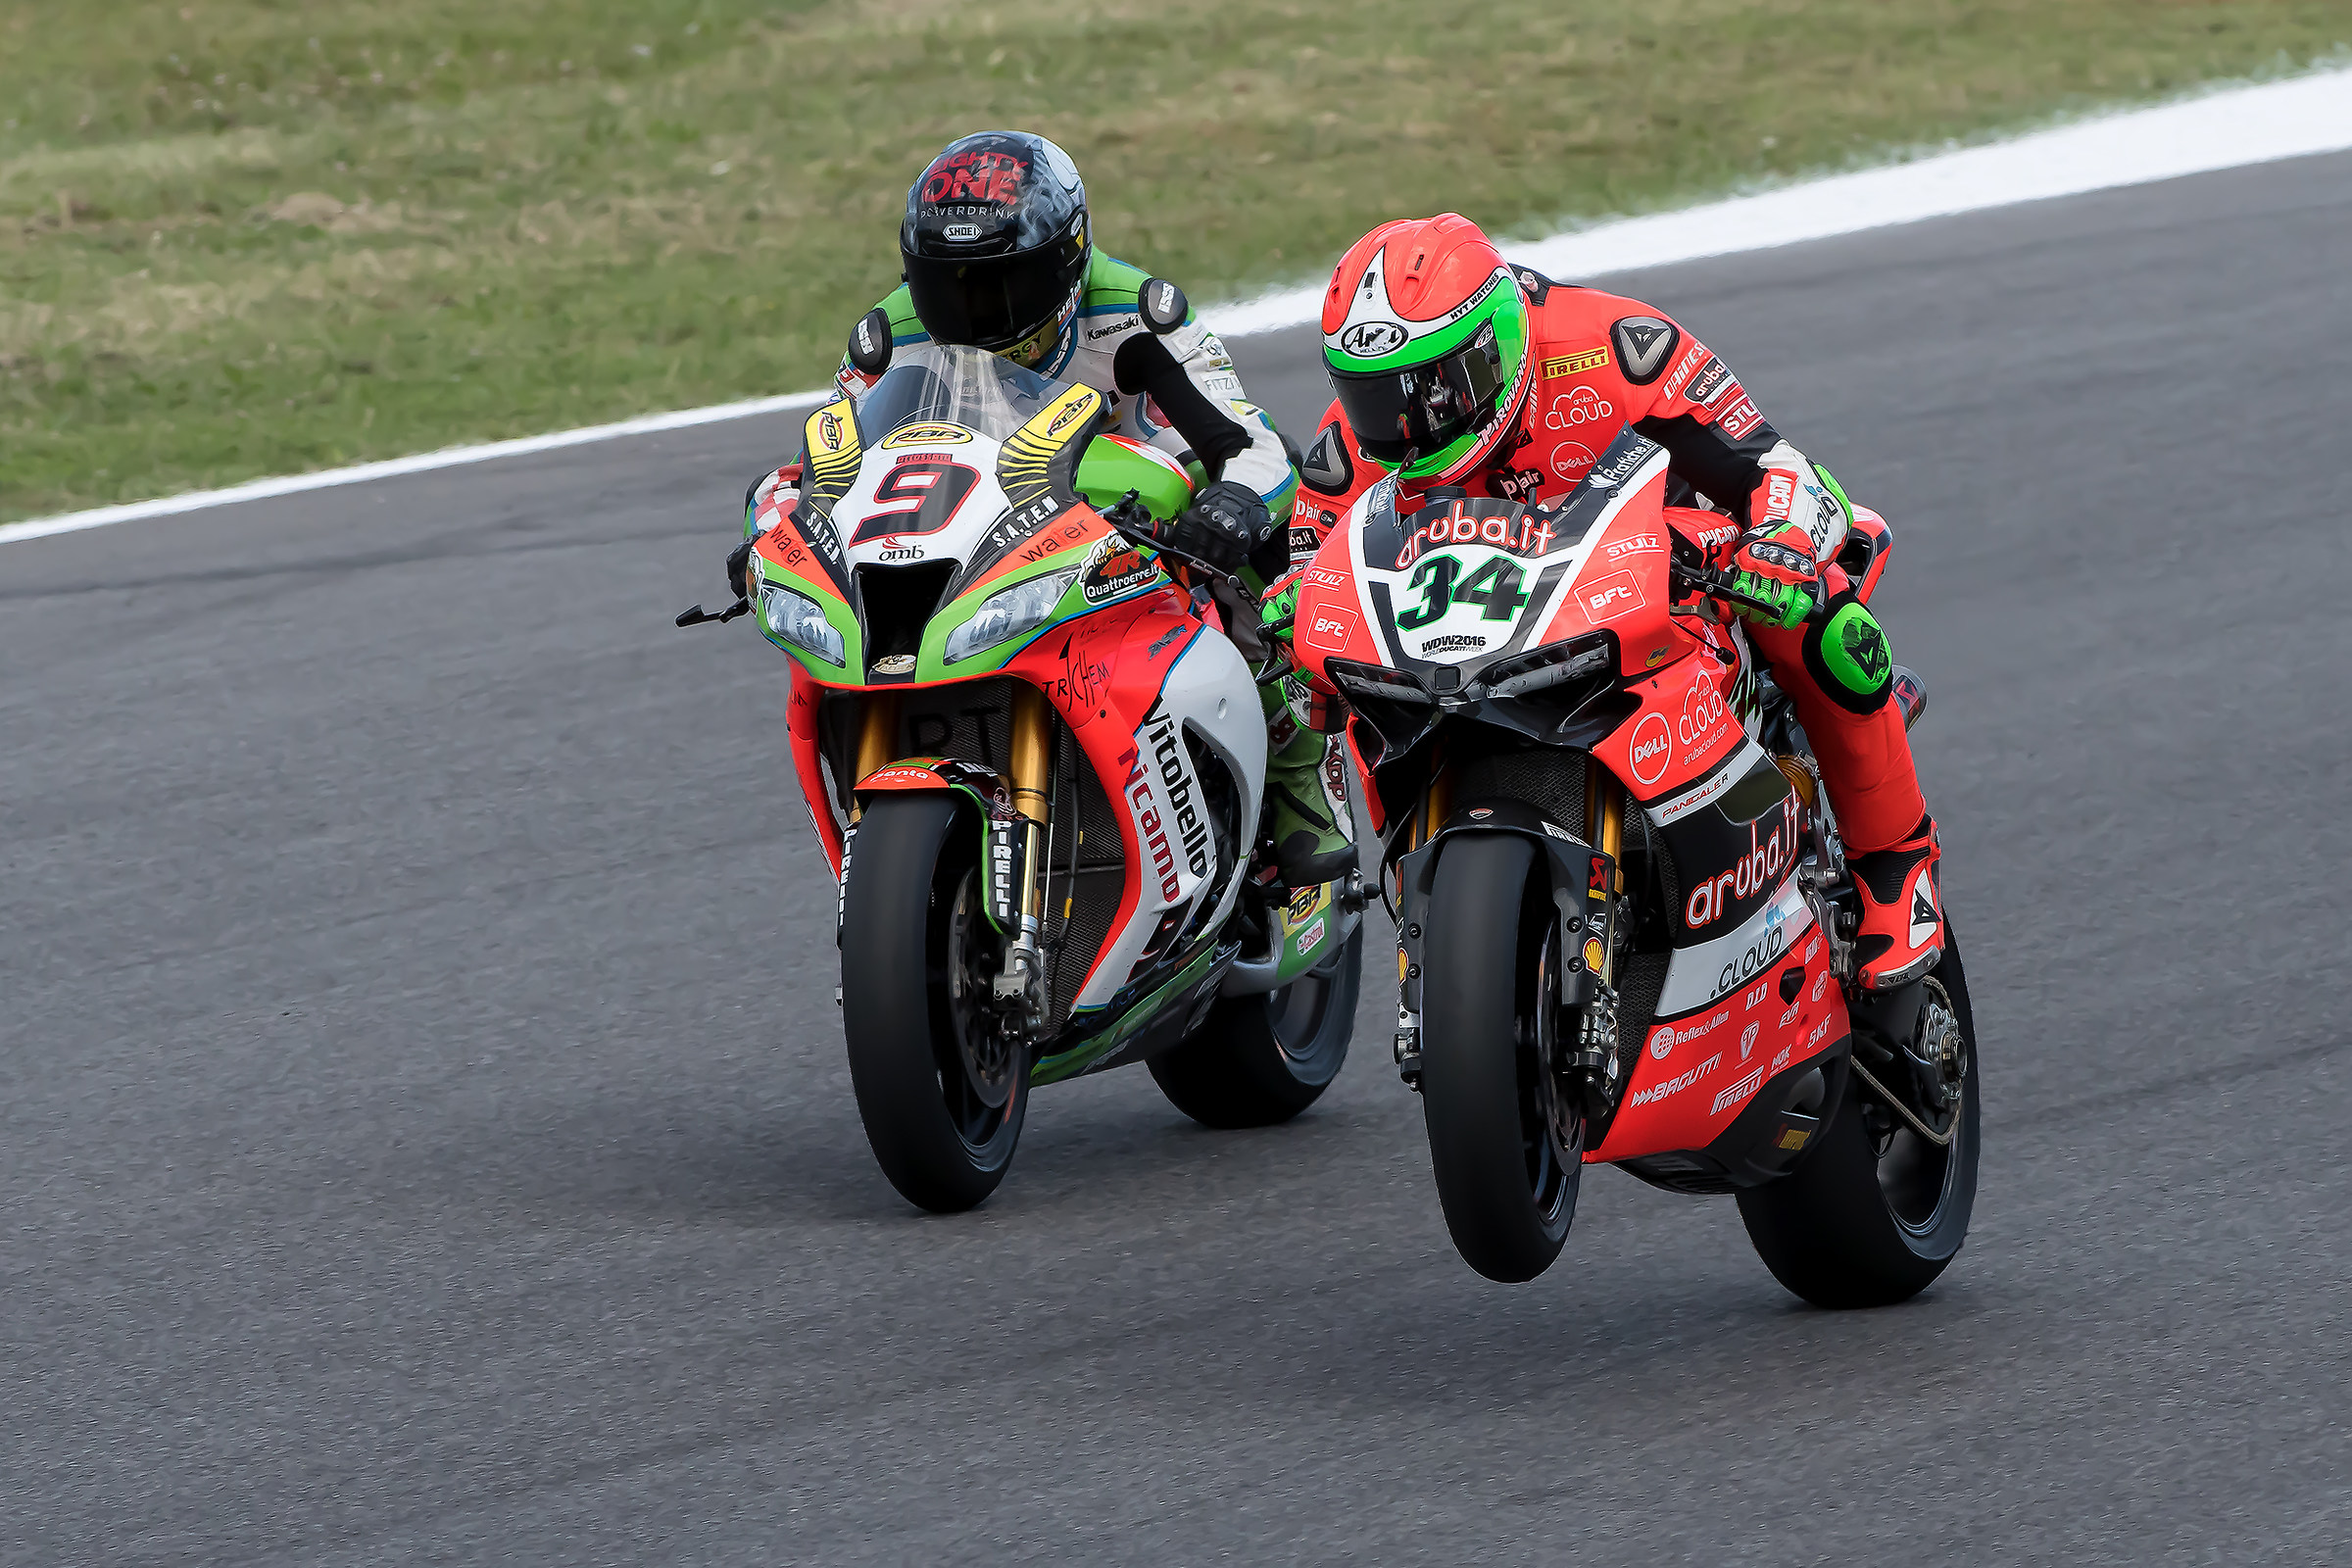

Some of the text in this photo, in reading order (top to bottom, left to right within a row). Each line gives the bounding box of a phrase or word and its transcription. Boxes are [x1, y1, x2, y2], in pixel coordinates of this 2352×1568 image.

[922, 168, 1019, 206] ONE
[948, 226, 978, 237] SHOEI
[1450, 272, 1500, 319] HYT WATCHES
[1087, 315, 1140, 342] Kawasaki
[1346, 325, 1400, 349] Ari
[1540, 348, 1608, 378] PIRELLI
[1544, 400, 1613, 430] CLOUD
[1555, 455, 1595, 471] DELL
[848, 462, 982, 551] 9
[1395, 500, 1557, 569] aruba.it
[1607, 537, 1660, 557] STULZ
[1696, 524, 1740, 549] DUCATI
[1086, 564, 1160, 599] Quattroerre.it
[1308, 568, 1346, 586] STULZ
[1395, 554, 1531, 632] 34
[1421, 635, 1487, 653] WDW2016
[1678, 690, 1724, 746] CLOUD
[1634, 734, 1669, 764] DELL
[1683, 722, 1730, 765] arubacloud.com
[1143, 694, 1210, 879] Vitobello
[992, 820, 1013, 917] PIRELLI
[1686, 782, 1801, 929] aruba.it
[1807, 1012, 1832, 1050] SKF
[1709, 1064, 1765, 1116] PIRELLI
